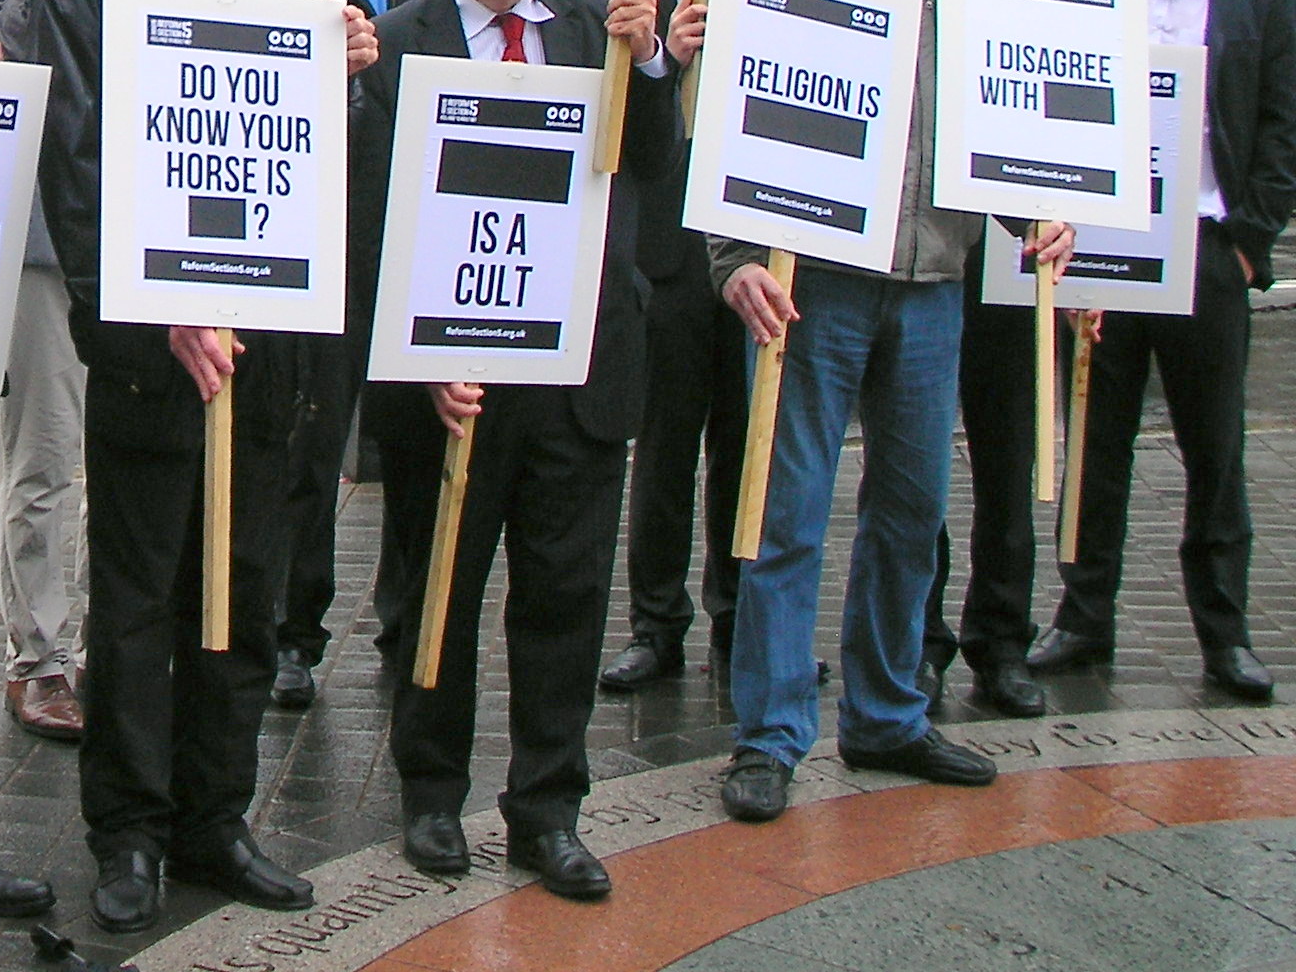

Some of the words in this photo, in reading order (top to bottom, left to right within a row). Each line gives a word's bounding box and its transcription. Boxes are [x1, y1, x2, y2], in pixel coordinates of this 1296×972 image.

[987, 40, 990, 67] I
[1001, 42, 1110, 83] DISAGREE
[181, 63, 215, 100] DO
[226, 67, 278, 106] YOU
[739, 56, 851, 111] RELIGION
[858, 84, 880, 117] IS
[980, 76, 1037, 110] WITH
[147, 105, 229, 146] KNOW
[239, 112, 310, 153] YOUR
[167, 151, 257, 193] HORSE
[268, 159, 290, 196] IS
[254, 203, 269, 239] ?
[470, 211, 499, 253] IS
[506, 214, 525, 255] A
[455, 263, 533, 307] CULT
